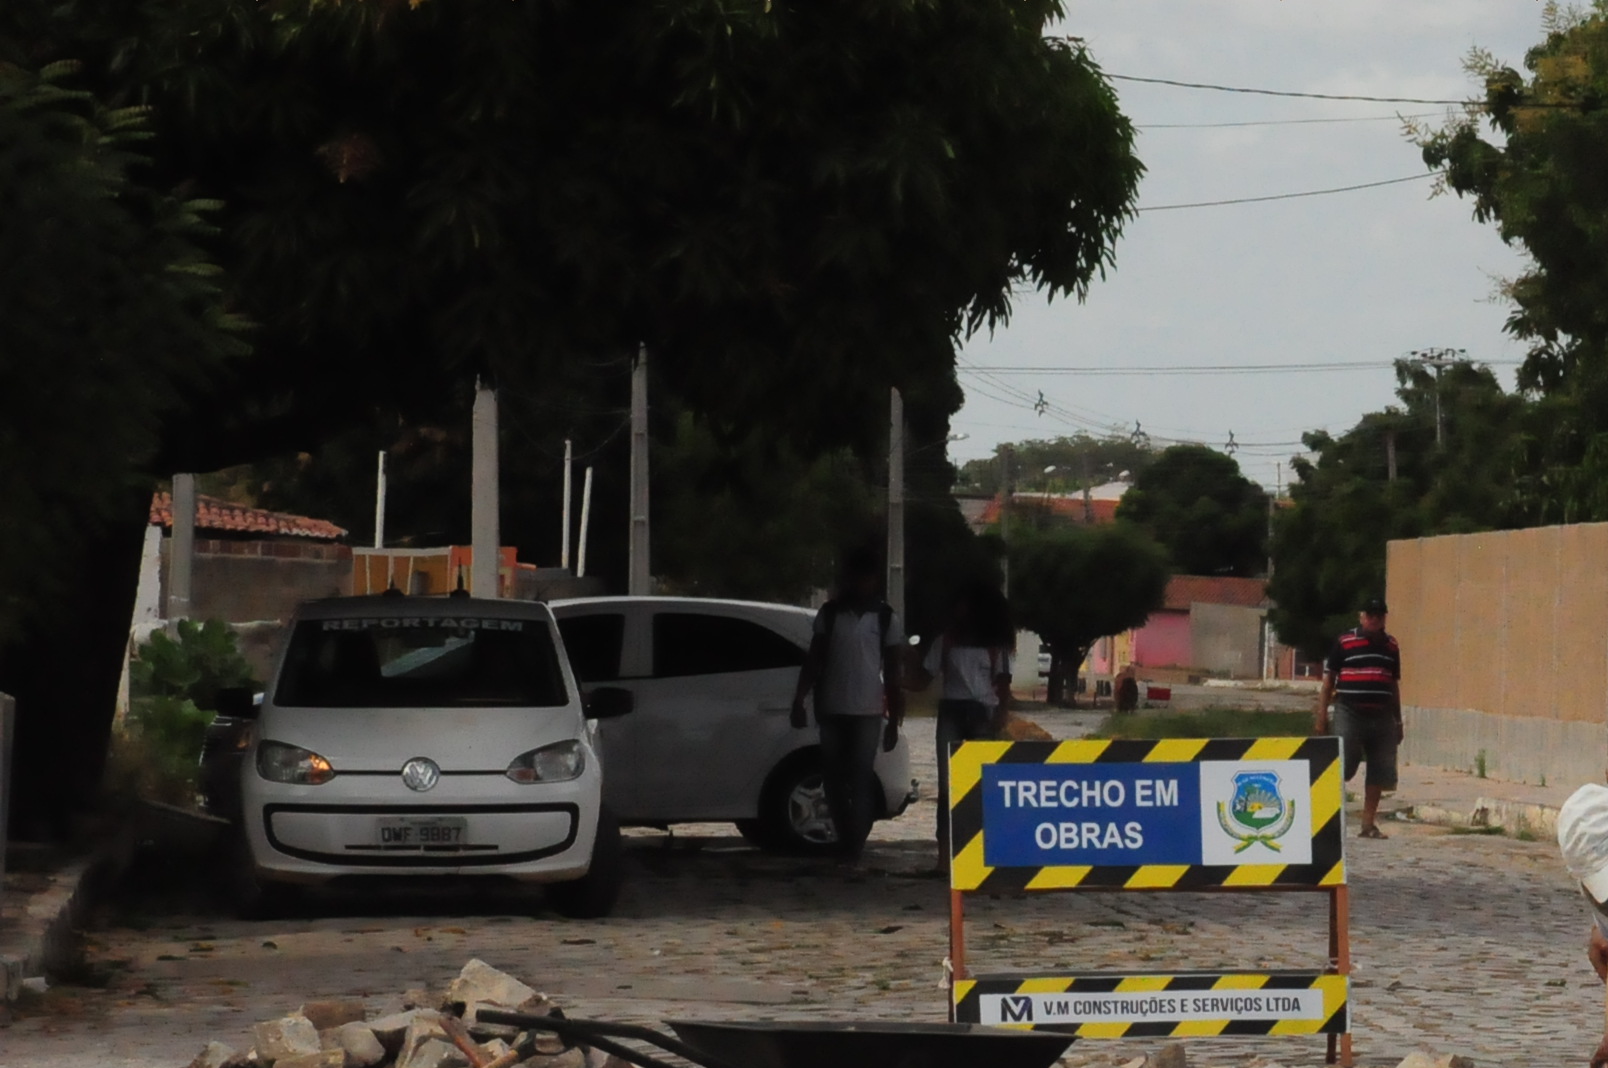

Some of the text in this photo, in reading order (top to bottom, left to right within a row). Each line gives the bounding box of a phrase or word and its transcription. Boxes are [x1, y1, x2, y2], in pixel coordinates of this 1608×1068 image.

[322, 617, 523, 632] REPORTAGEM
[998, 779, 1179, 808] TRECHO EM
[1035, 822, 1144, 849] OBRAS
[1043, 995, 1301, 1018] V.M CONSTRUÇÕES E SERVIÇOS LTDA
